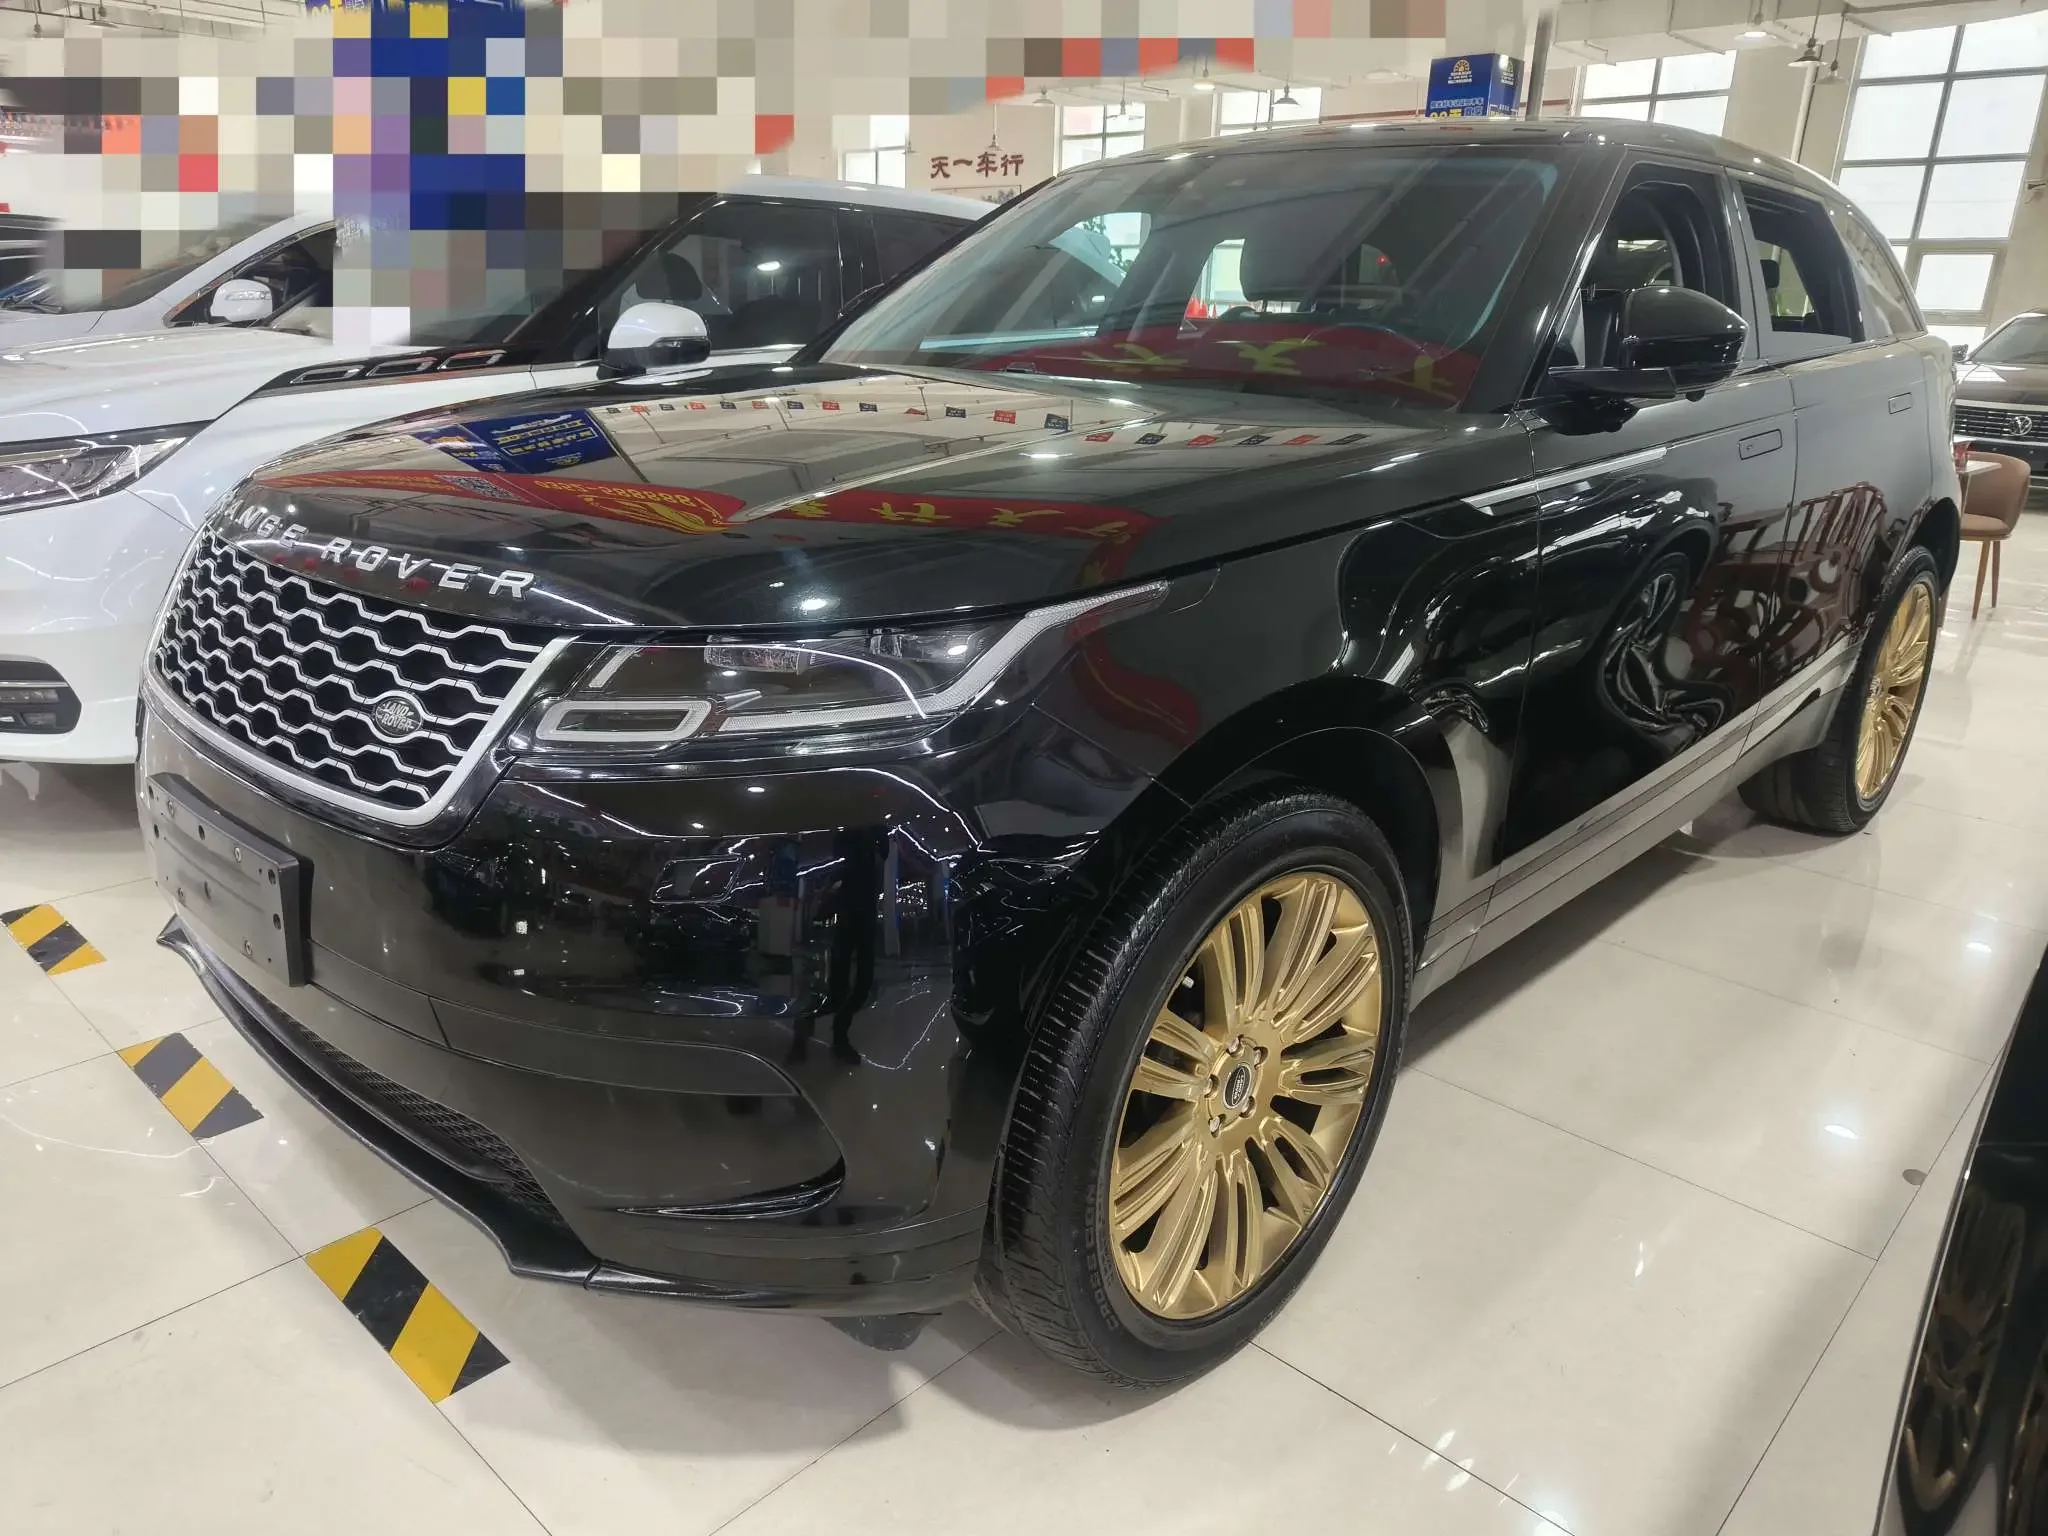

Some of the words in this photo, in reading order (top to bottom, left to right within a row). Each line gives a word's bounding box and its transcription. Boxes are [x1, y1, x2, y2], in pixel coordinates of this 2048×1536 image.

[930, 152, 1024, 178] 天一车行
[320, 536, 535, 600] ROVER
[383, 700, 410, 717] LAND
[381, 713, 414, 731] ROVER
